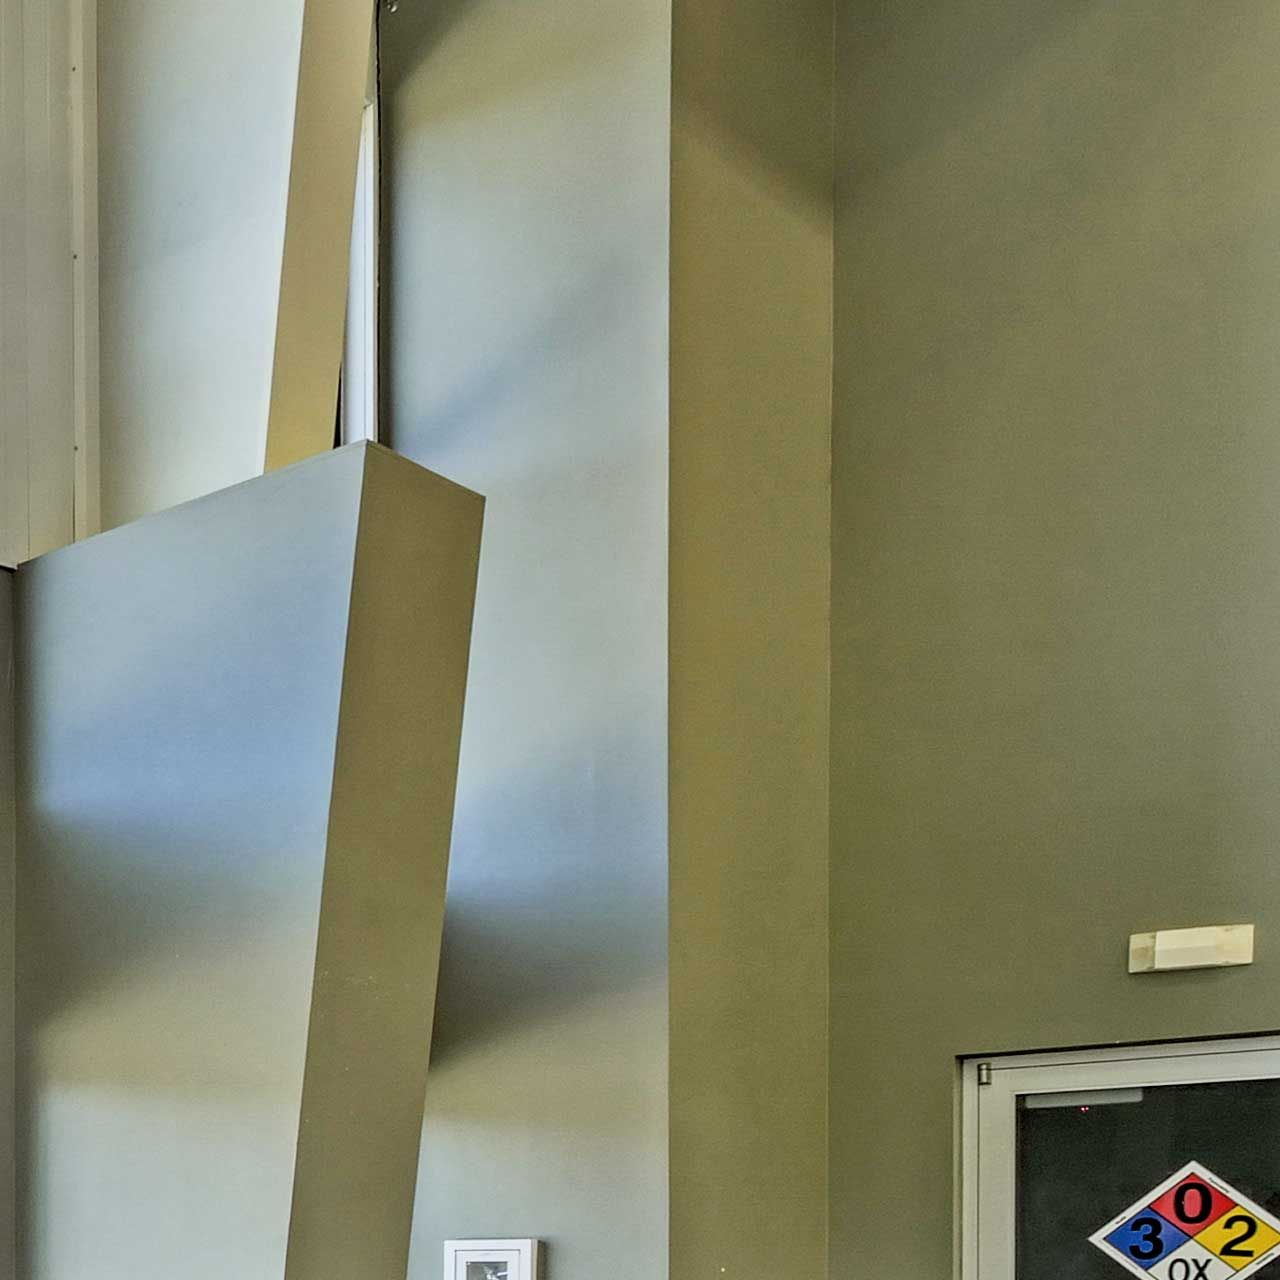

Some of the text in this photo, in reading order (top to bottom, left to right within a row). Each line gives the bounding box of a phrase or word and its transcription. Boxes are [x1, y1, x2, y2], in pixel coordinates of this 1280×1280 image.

[1174, 1182, 1213, 1224] 0
[1129, 1217, 1164, 1260] 3
[1219, 1215, 1257, 1257] 2
